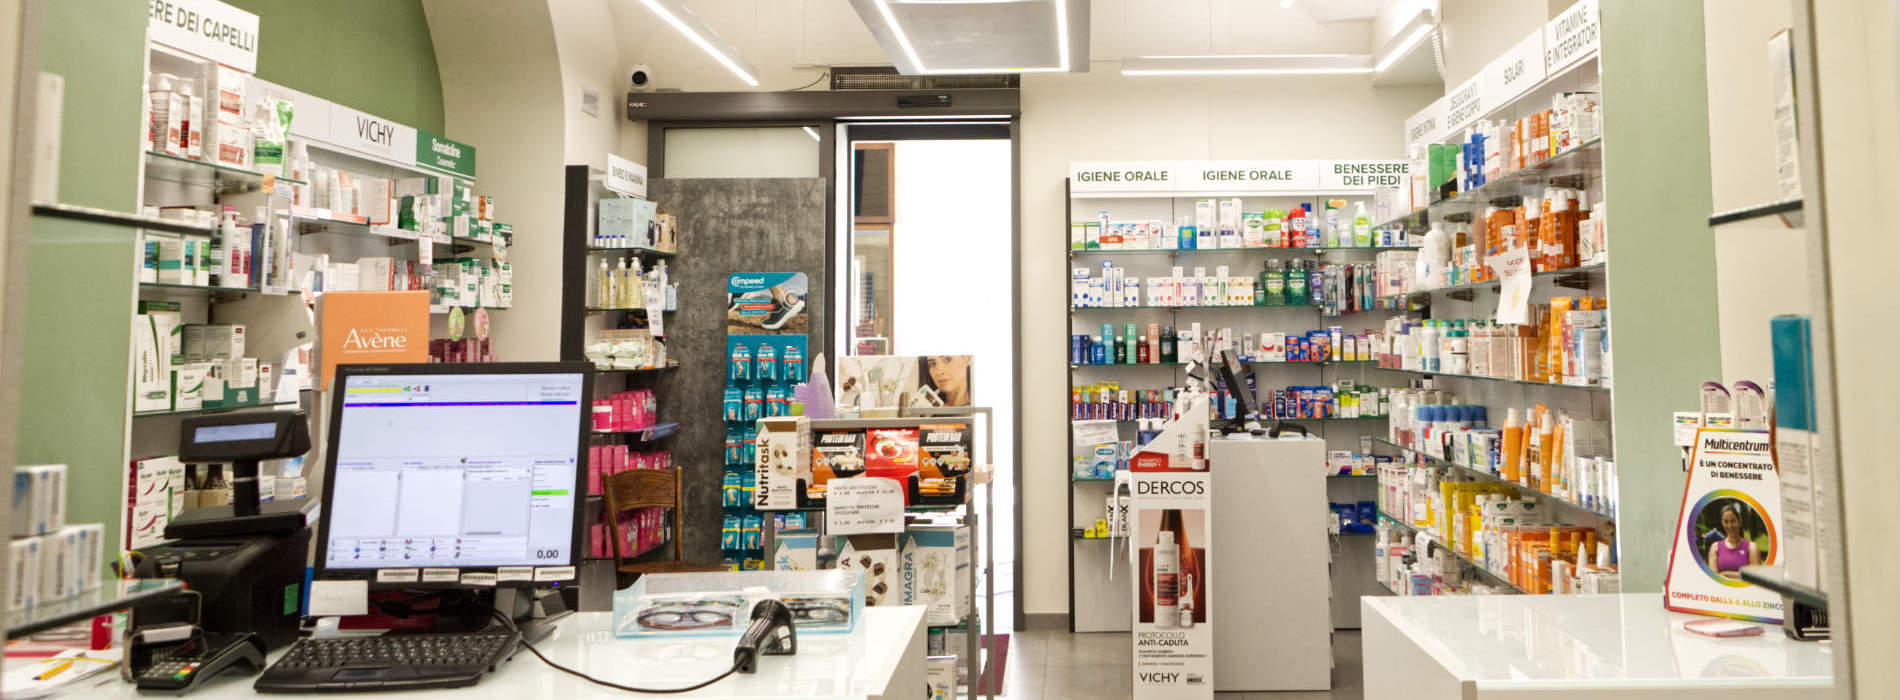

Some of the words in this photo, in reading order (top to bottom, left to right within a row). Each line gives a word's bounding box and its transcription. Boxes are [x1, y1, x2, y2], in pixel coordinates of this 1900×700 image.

[1555, 5, 1588, 42] VITAMINE
[176, 8, 199, 33] DEI
[203, 18, 254, 52] CAPELLI
[1504, 58, 1525, 86] SOLARI
[356, 116, 394, 146] VICHY
[1334, 163, 1409, 174] BENESSERE
[1077, 170, 1121, 182] IGIENE
[1124, 170, 1168, 182] ORALE
[1202, 170, 1246, 182] IGIENE
[1249, 170, 1292, 181] ORALE
[1342, 175, 1364, 186] DEI
[1368, 174, 1400, 186] PIEDI
[732, 276, 764, 286] Compeed
[344, 328, 408, 348] Avène
[1704, 438, 1768, 452] Multicentrum
[1717, 461, 1773, 470] CONCENTRATO
[757, 439, 770, 506] Nutritask
[1720, 471, 1763, 481] BENESSERE
[1138, 481, 1204, 494] DERCOS
[536, 550, 559, 560] 0,00
[1672, 592, 1709, 602] COMPLETO
[1711, 596, 1733, 604] DALLA
[1742, 600, 1760, 608] ALLO
[1139, 672, 1179, 683] VICHY
